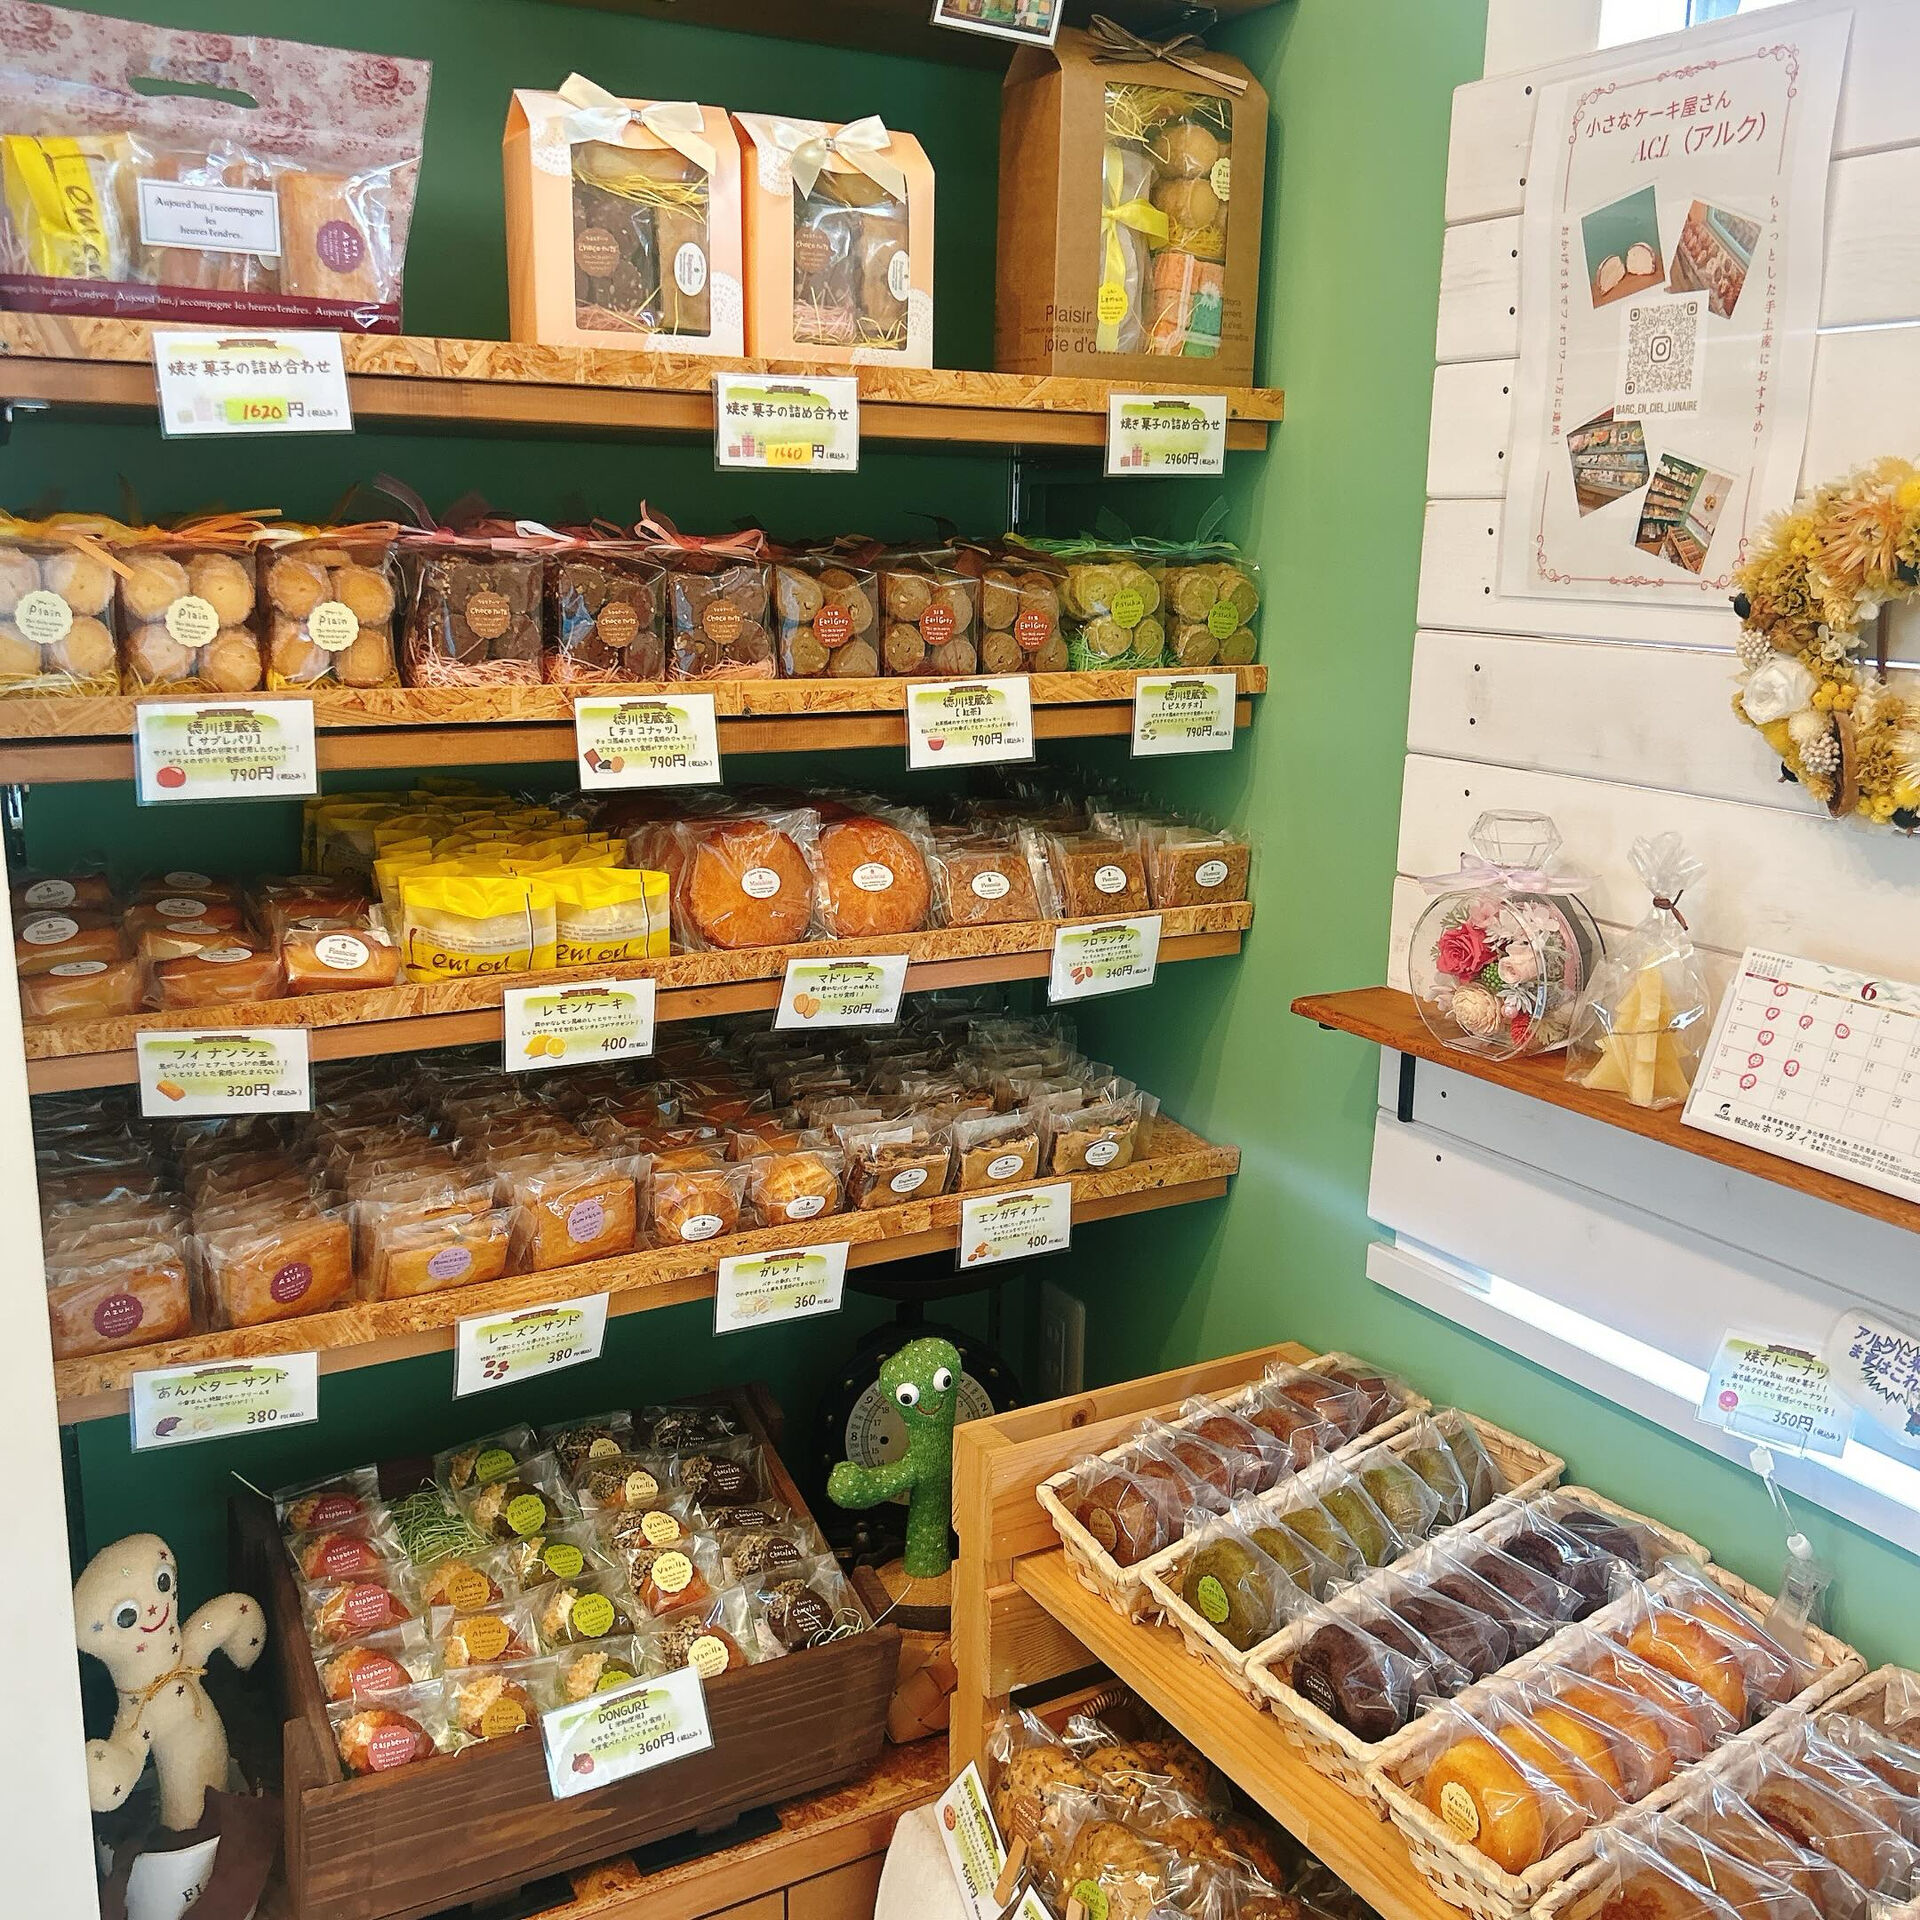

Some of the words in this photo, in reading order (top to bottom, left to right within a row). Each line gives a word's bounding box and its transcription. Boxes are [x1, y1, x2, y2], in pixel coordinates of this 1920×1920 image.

[1586, 90, 1732, 138] 小さなケーキ屋さん
[205, 216, 217, 224] les
[1045, 305, 1092, 324] Plaisir
[1043, 335, 1069, 356] joie
[168, 359, 331, 377] 焼き菓子の詰め合わせ
[243, 401, 304, 420] 1620円
[726, 402, 849, 421] 焼き菓子の詰め合わせ
[1120, 417, 1220, 431] 焼き菓子の詰め合わせ
[1164, 452, 1199, 465] 2960円
[29, 604, 62, 618] Plain
[178, 608, 208, 621] Plain
[318, 615, 348, 627] Plain
[943, 694, 995, 708] 徳川埋蔵金
[1165, 688, 1210, 701] 徳川埋蔵金
[955, 707, 981, 717] 【紅茶】
[1161, 701, 1204, 711] 【ピスタチオ】
[613, 712, 676, 726] 徳川埋蔵金
[187, 720, 263, 735] 徳川埋蔵金
[609, 725, 678, 736] 【チョコナッツ】
[1186, 724, 1212, 737] 790円
[972, 732, 1002, 746] 790円
[650, 753, 686, 768] 790円
[230, 765, 274, 782] 790円
[1081, 934, 1135, 947] フロランタン
[818, 972, 875, 984] マドレーヌ
[1106, 965, 1133, 978] 340円
[1861, 982, 1880, 1001] 6
[543, 998, 624, 1017] レモンケーキ
[840, 1003, 872, 1015] 350円
[601, 1036, 627, 1051] 400
[1795, 1041, 1804, 1049] 16
[174, 1047, 269, 1060] フィナンシェ
[1830, 1051, 1839, 1059] 17
[1866, 1061, 1875, 1069] 18
[1903, 1072, 1912, 1080] 19
[227, 1083, 270, 1097] 320円
[1734, 1116, 1760, 1131] 株式会社
[1762, 1123, 1806, 1146] ホウダイ
[979, 1204, 1050, 1224] エンガディナー
[1027, 1235, 1048, 1248] 400
[760, 1262, 804, 1278] ガレット
[278, 1272, 306, 1285] Azuki
[794, 1294, 816, 1308] 360
[103, 1304, 135, 1318] Azuki
[489, 1314, 581, 1344] レーズンサンド
[547, 1347, 573, 1364] 380
[1743, 1349, 1831, 1380] 焼きドーナツ
[157, 1371, 289, 1399] あんバターサンド
[864, 1396, 873, 1404] 9
[980, 1402, 988, 1411] 2
[247, 1409, 278, 1424] 380
[1772, 1410, 1814, 1432] 350円
[851, 1432, 858, 1441] 8
[656, 1560, 687, 1574] Vanilla
[472, 1627, 502, 1638] Almond
[693, 1646, 722, 1662] Vanilla
[598, 1700, 650, 1724] DONGURI
[372, 1736, 411, 1750] Raspberry
[638, 1731, 675, 1755] 360円
[962, 1862, 979, 1898] 450円
